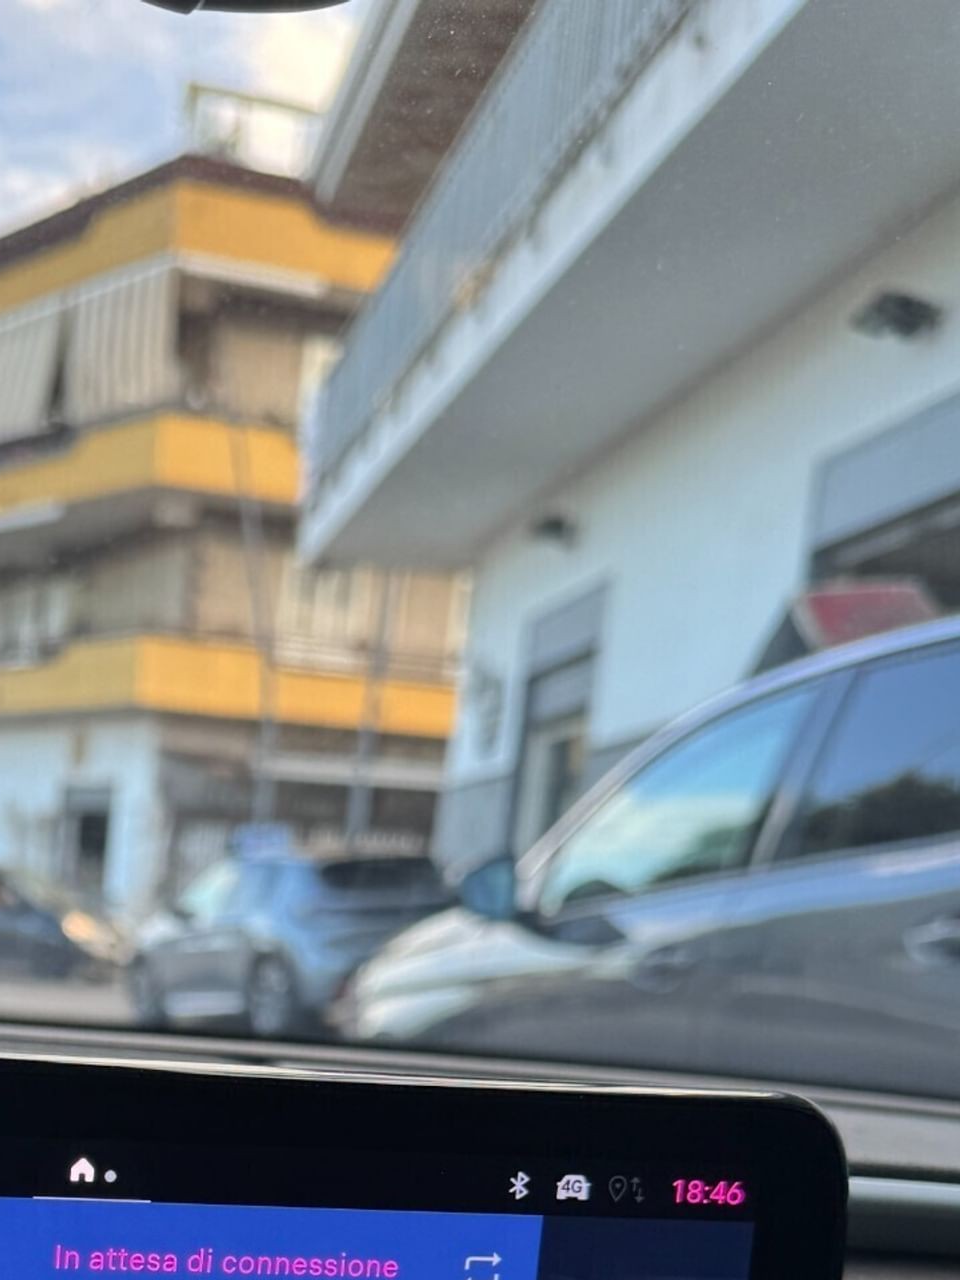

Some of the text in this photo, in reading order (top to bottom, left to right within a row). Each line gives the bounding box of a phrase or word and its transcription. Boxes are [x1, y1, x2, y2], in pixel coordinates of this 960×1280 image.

[561, 1178, 584, 1195] 4G
[673, 1179, 746, 1205] 18:46
[54, 1244, 399, 1280] In attesa di connessione
